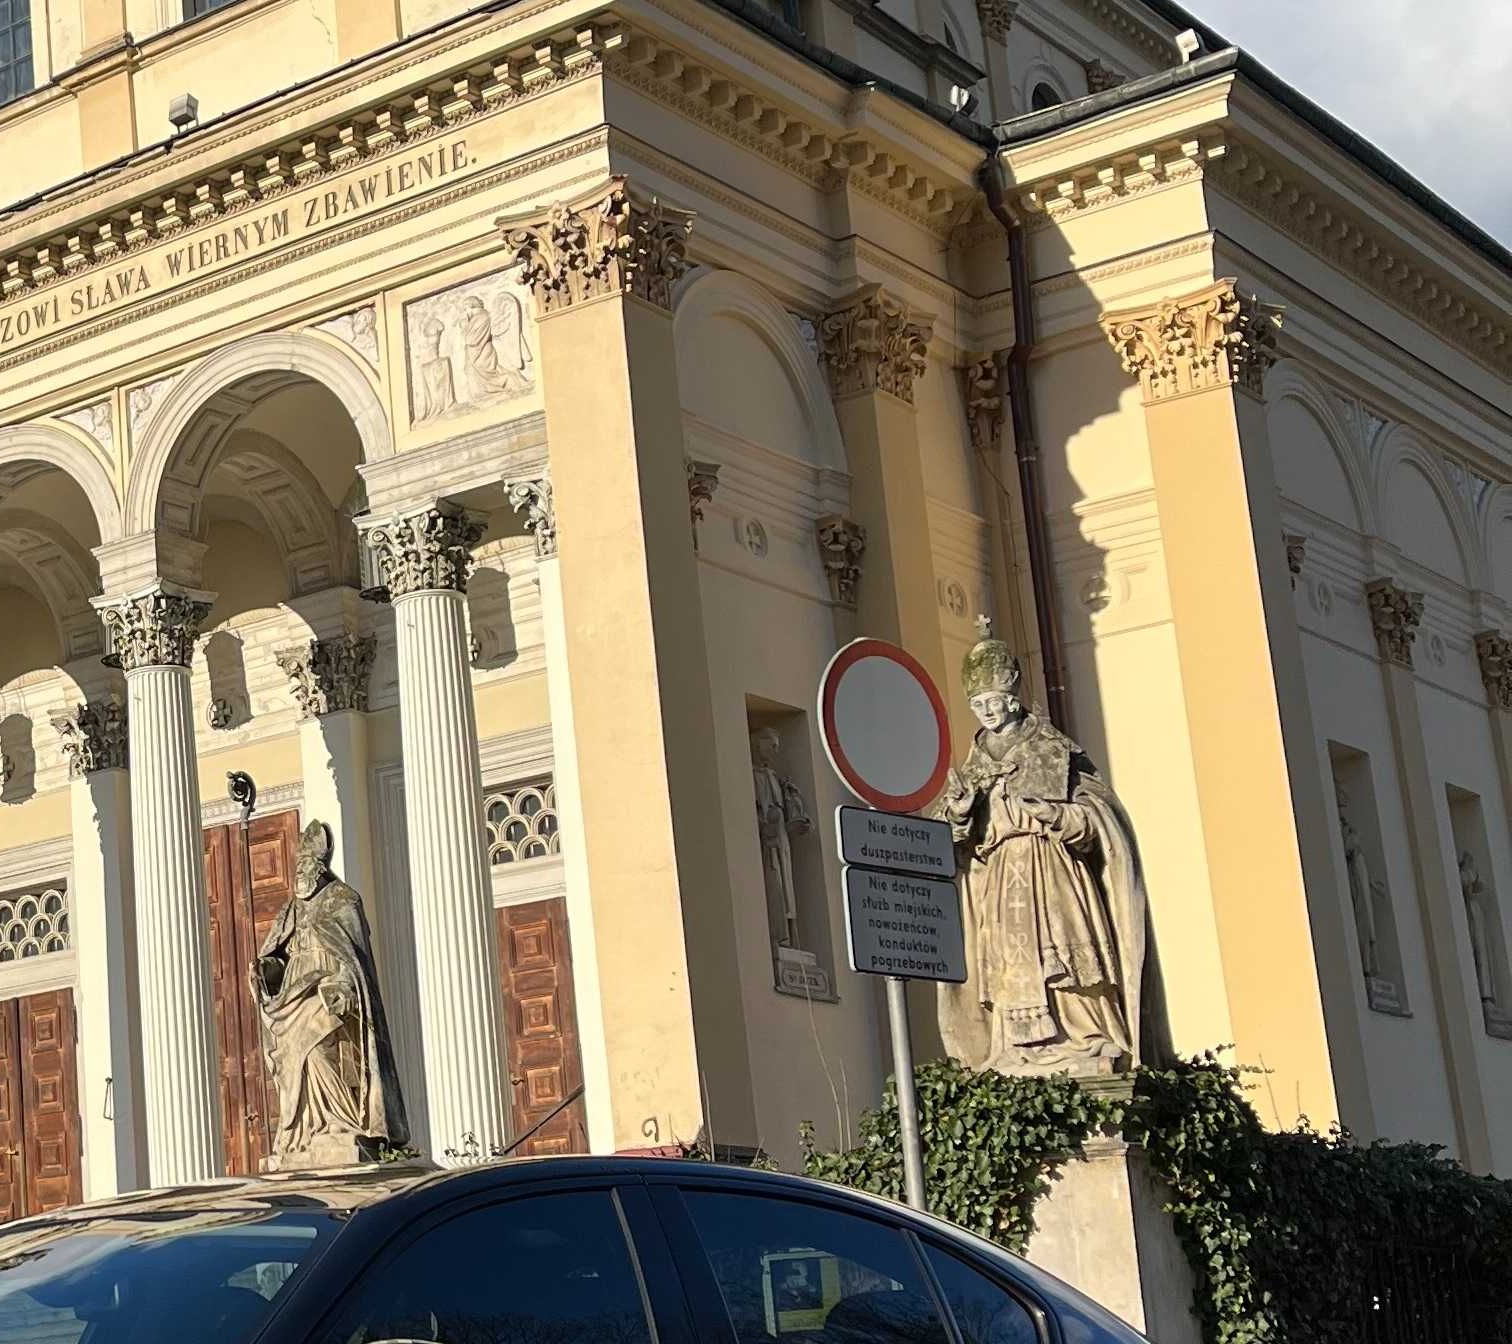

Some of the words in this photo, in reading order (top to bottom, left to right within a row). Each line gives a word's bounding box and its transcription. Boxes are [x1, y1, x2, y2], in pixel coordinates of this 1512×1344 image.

[868, 819, 887, 834] Nie
[891, 823, 932, 845] dotyczy
[860, 844, 943, 867] duszpasterstwa
[868, 875, 887, 891] Nie
[892, 879, 932, 901] dotyczy
[871, 955, 949, 975] pogrzebowych
